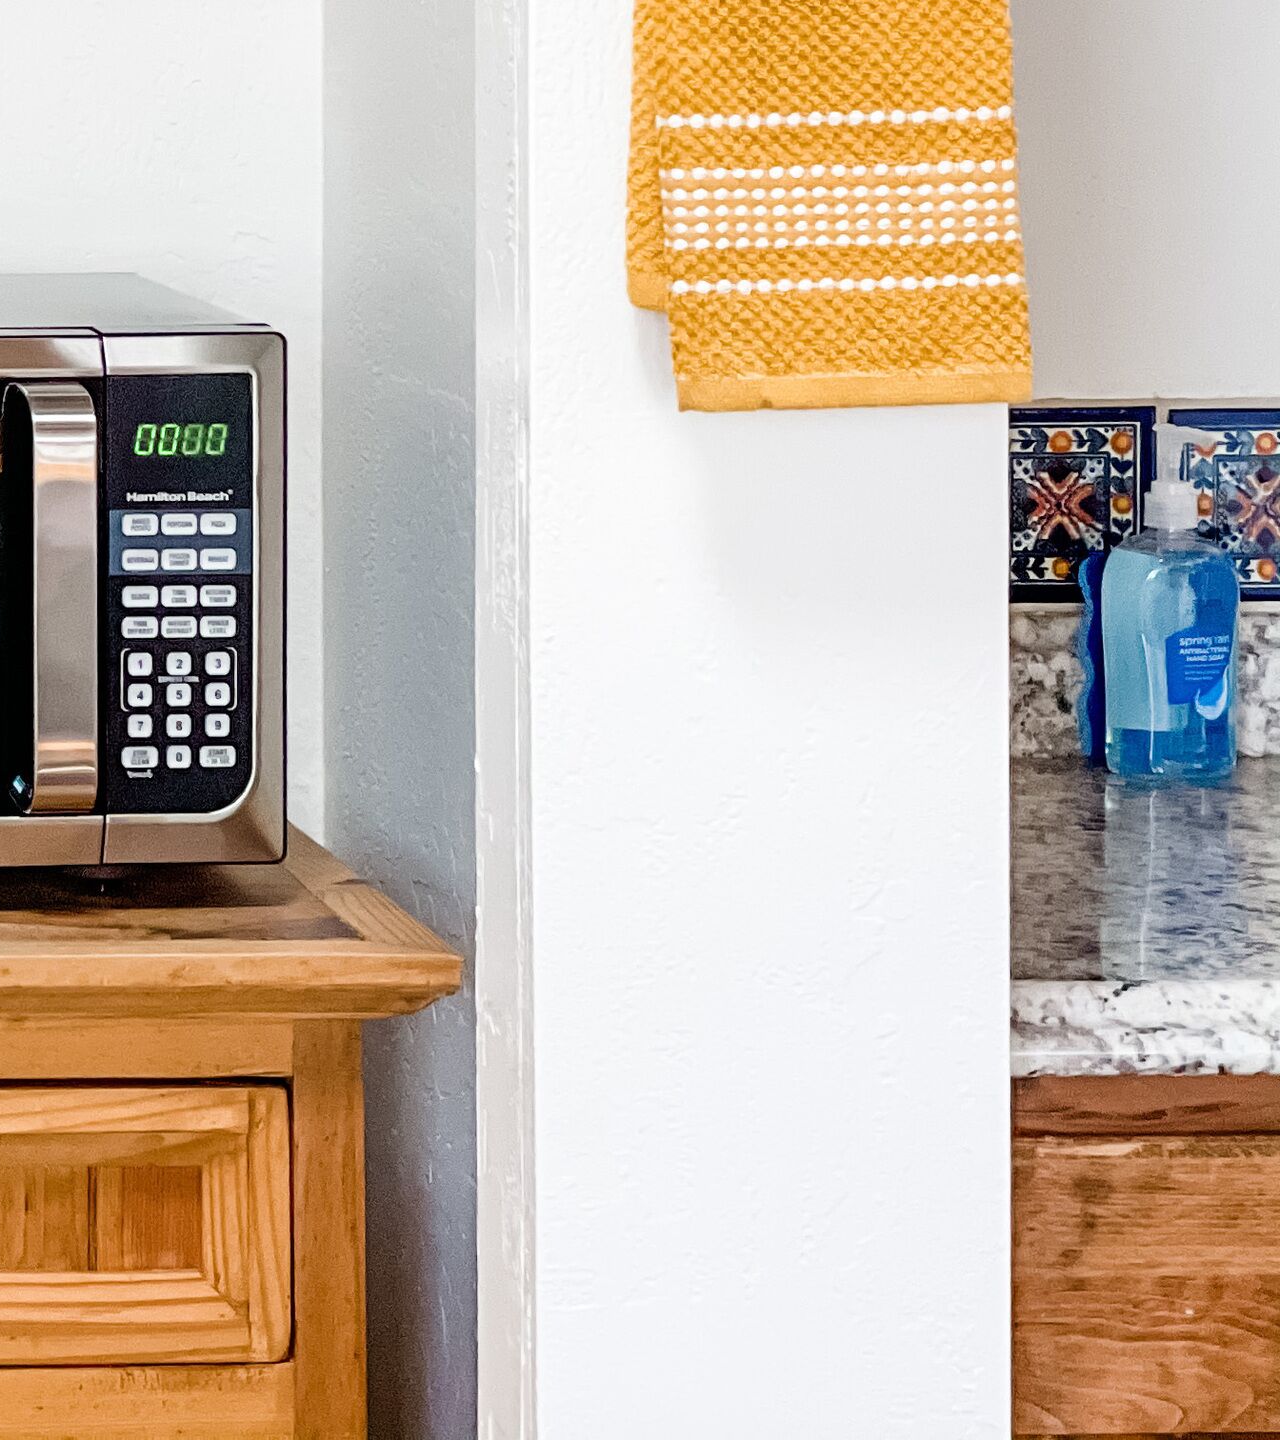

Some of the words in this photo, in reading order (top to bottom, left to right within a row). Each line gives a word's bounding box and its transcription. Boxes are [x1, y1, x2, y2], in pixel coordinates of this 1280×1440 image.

[126, 492, 186, 502] Hamilton
[176, 659, 183, 669] 2
[215, 658, 222, 668] 3
[136, 690, 144, 700] 4
[176, 690, 183, 700] 5
[214, 689, 222, 699] 6
[137, 721, 144, 731] 7
[176, 720, 183, 731] 8
[214, 720, 222, 730] 9
